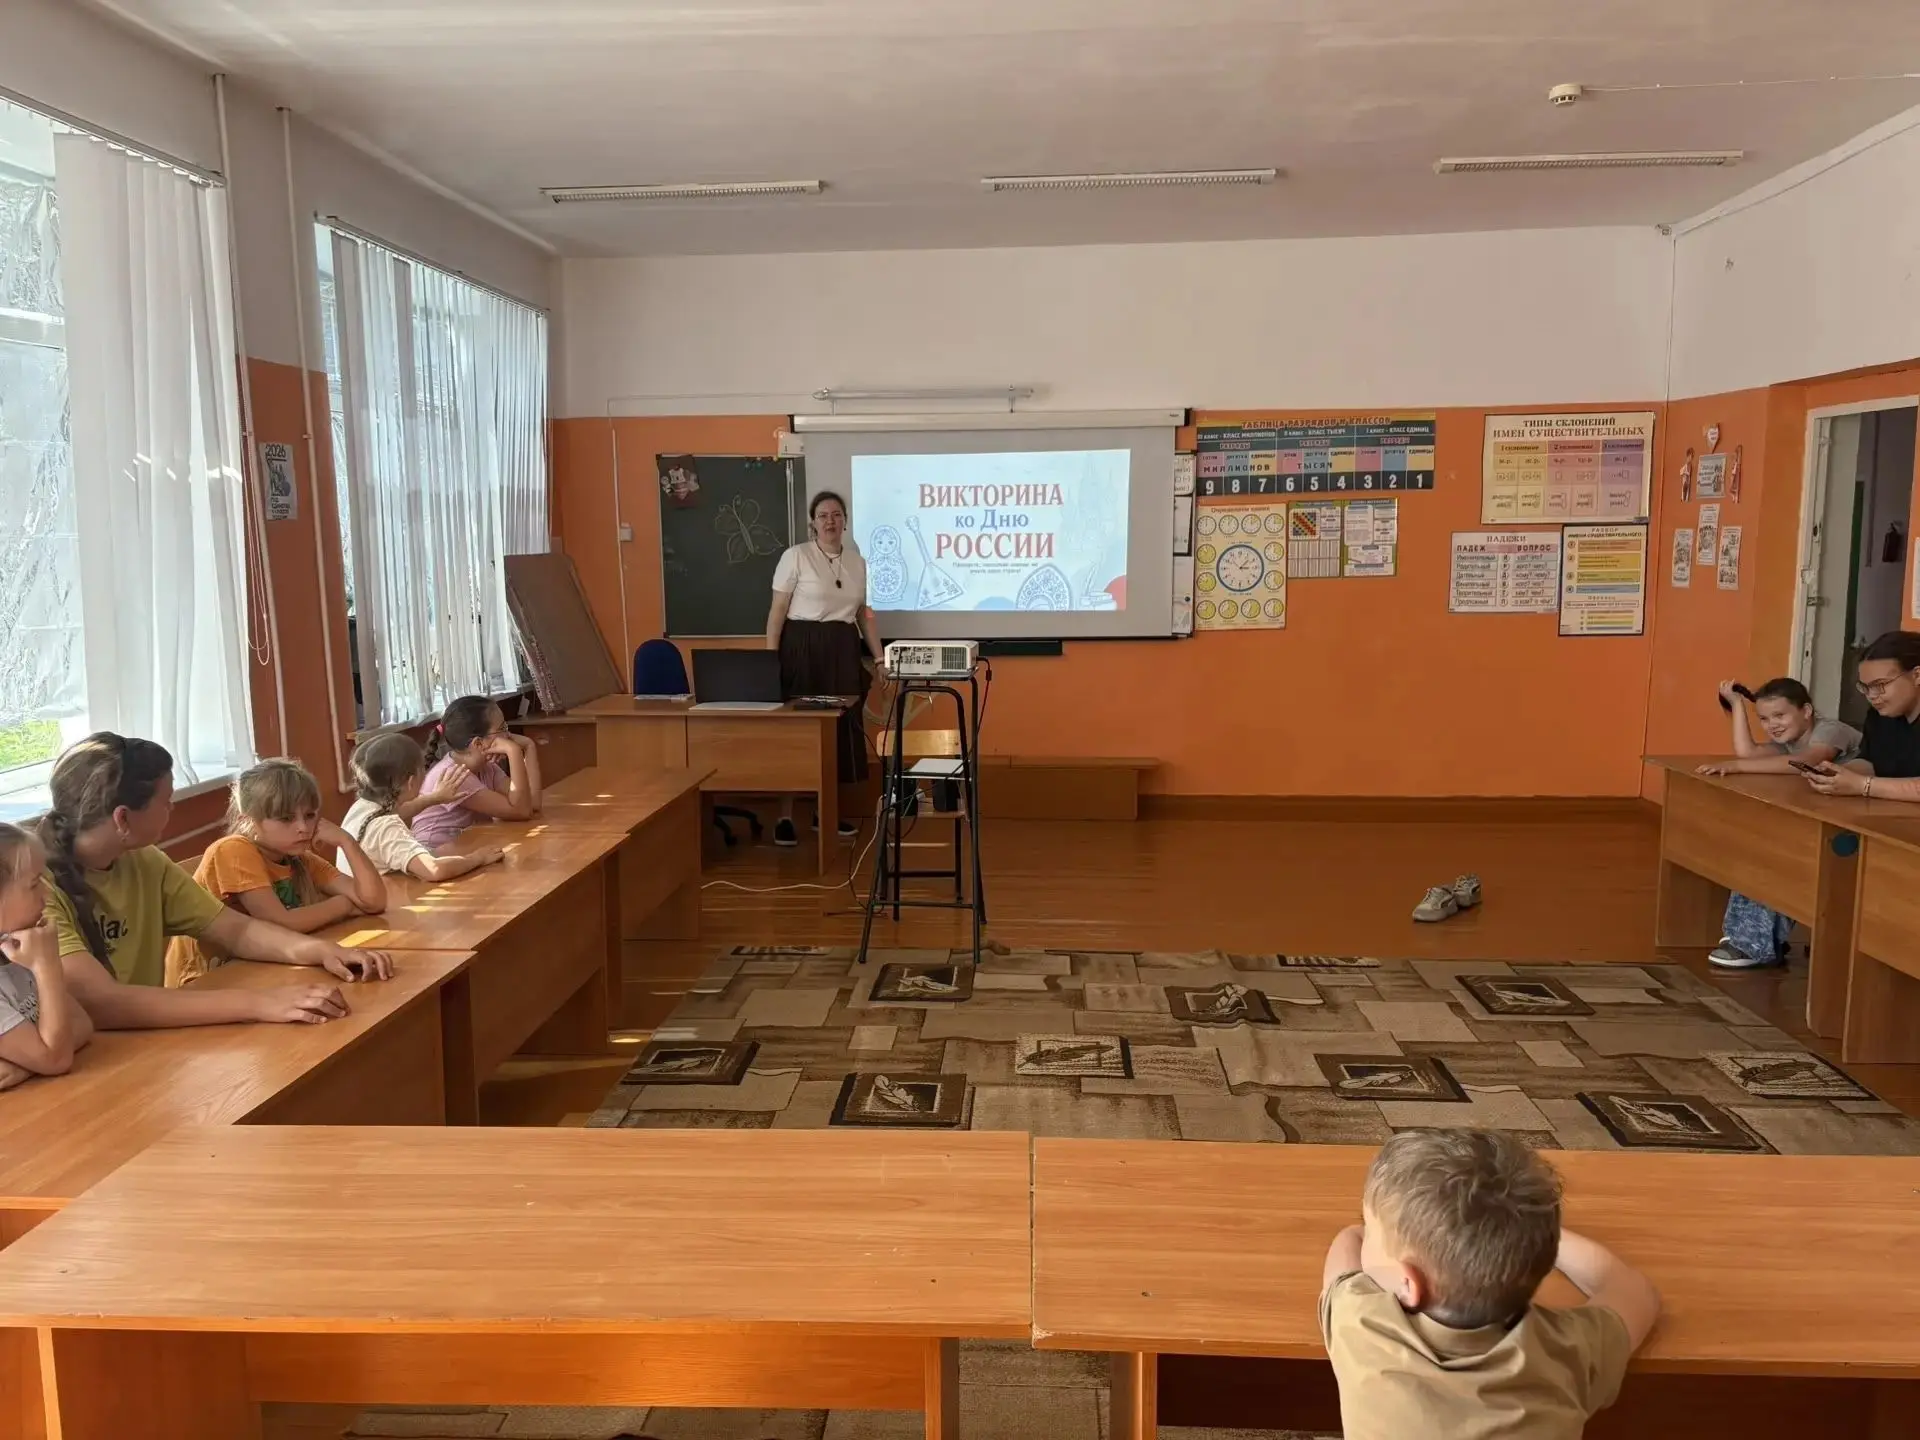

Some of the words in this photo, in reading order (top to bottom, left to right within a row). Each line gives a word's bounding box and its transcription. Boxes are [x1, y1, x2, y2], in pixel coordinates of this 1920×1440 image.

[1523, 419, 1553, 428] ТИПЫ
[1556, 417, 1615, 426] СКЛОНЕНИЙ
[1493, 429, 1526, 438] ИМЕН
[1529, 427, 1644, 438] СУЩЕСТВИТЕЛЬНЫХ
[1204, 463, 1270, 473] МИЛЛИОНОВ
[1297, 461, 1332, 470] ТЫСЯЧ
[1205, 480, 1214, 495] 9
[1231, 479, 1240, 493] 8
[1258, 478, 1267, 492] 7
[1285, 477, 1295, 492] 6
[1310, 476, 1319, 491] 5
[1337, 475, 1346, 490] 4
[1363, 474, 1372, 489] 3
[1389, 474, 1397, 489] 2
[1416, 473, 1423, 488] 1
[919, 483, 1064, 508] ВИКТОРИНА
[955, 515, 975, 528] ко
[980, 509, 1029, 531] Дню
[935, 533, 1055, 559] РОССИИ
[1486, 535, 1527, 543] ПАДЕЖИ
[1517, 544, 1552, 552] ВОПРОС
